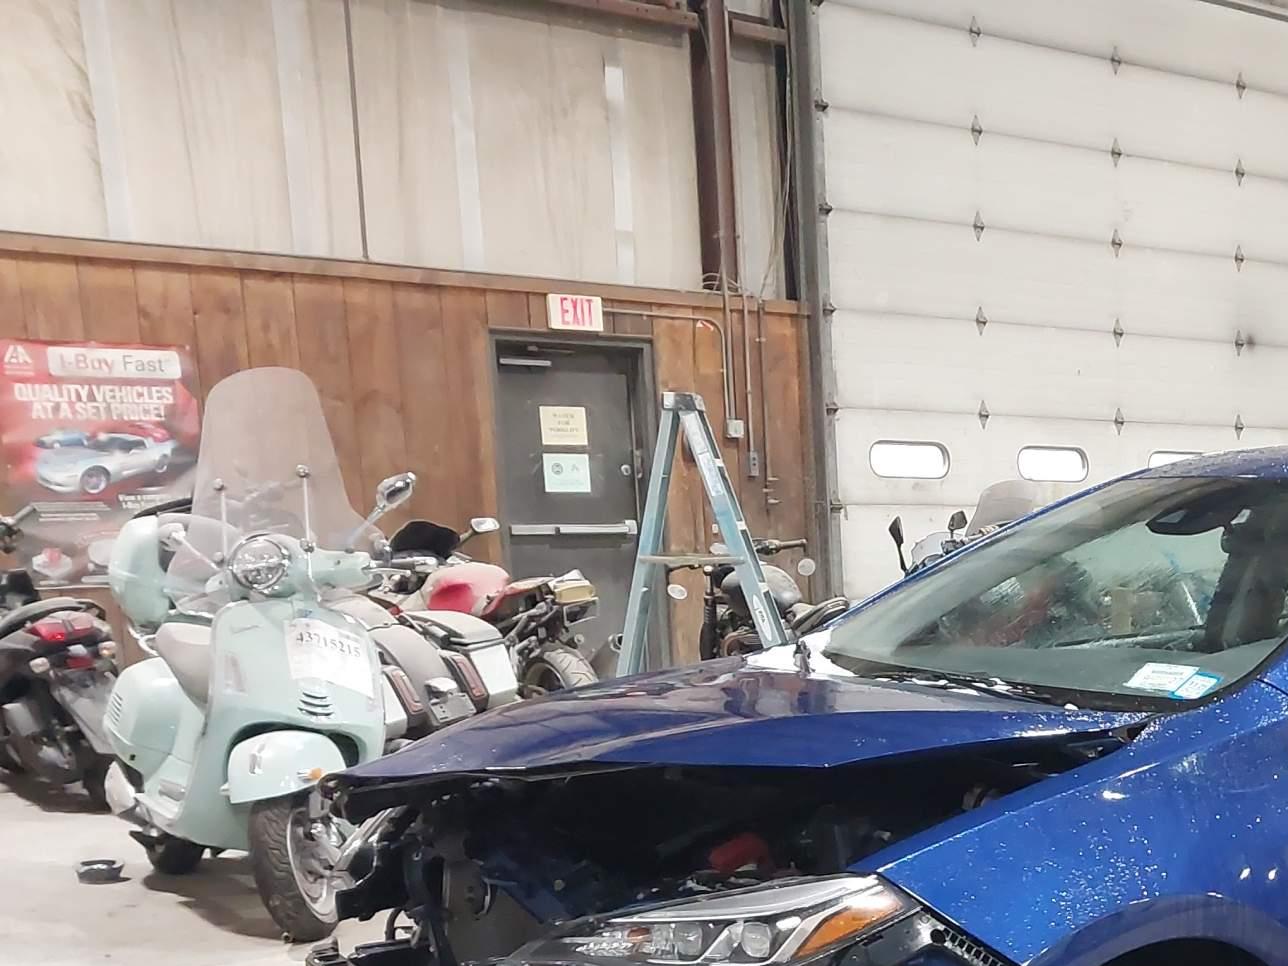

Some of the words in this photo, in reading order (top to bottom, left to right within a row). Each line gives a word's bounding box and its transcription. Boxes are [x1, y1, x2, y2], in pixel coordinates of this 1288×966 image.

[560, 296, 593, 327] EXIT
[59, 353, 113, 374] I-Buy
[122, 354, 165, 373] Fast
[14, 383, 93, 401] QUALITY
[94, 385, 174, 404] VEHICLES
[32, 402, 58, 419] AT
[59, 403, 73, 419] A
[75, 403, 107, 420] SET
[111, 404, 165, 421] PRICE!
